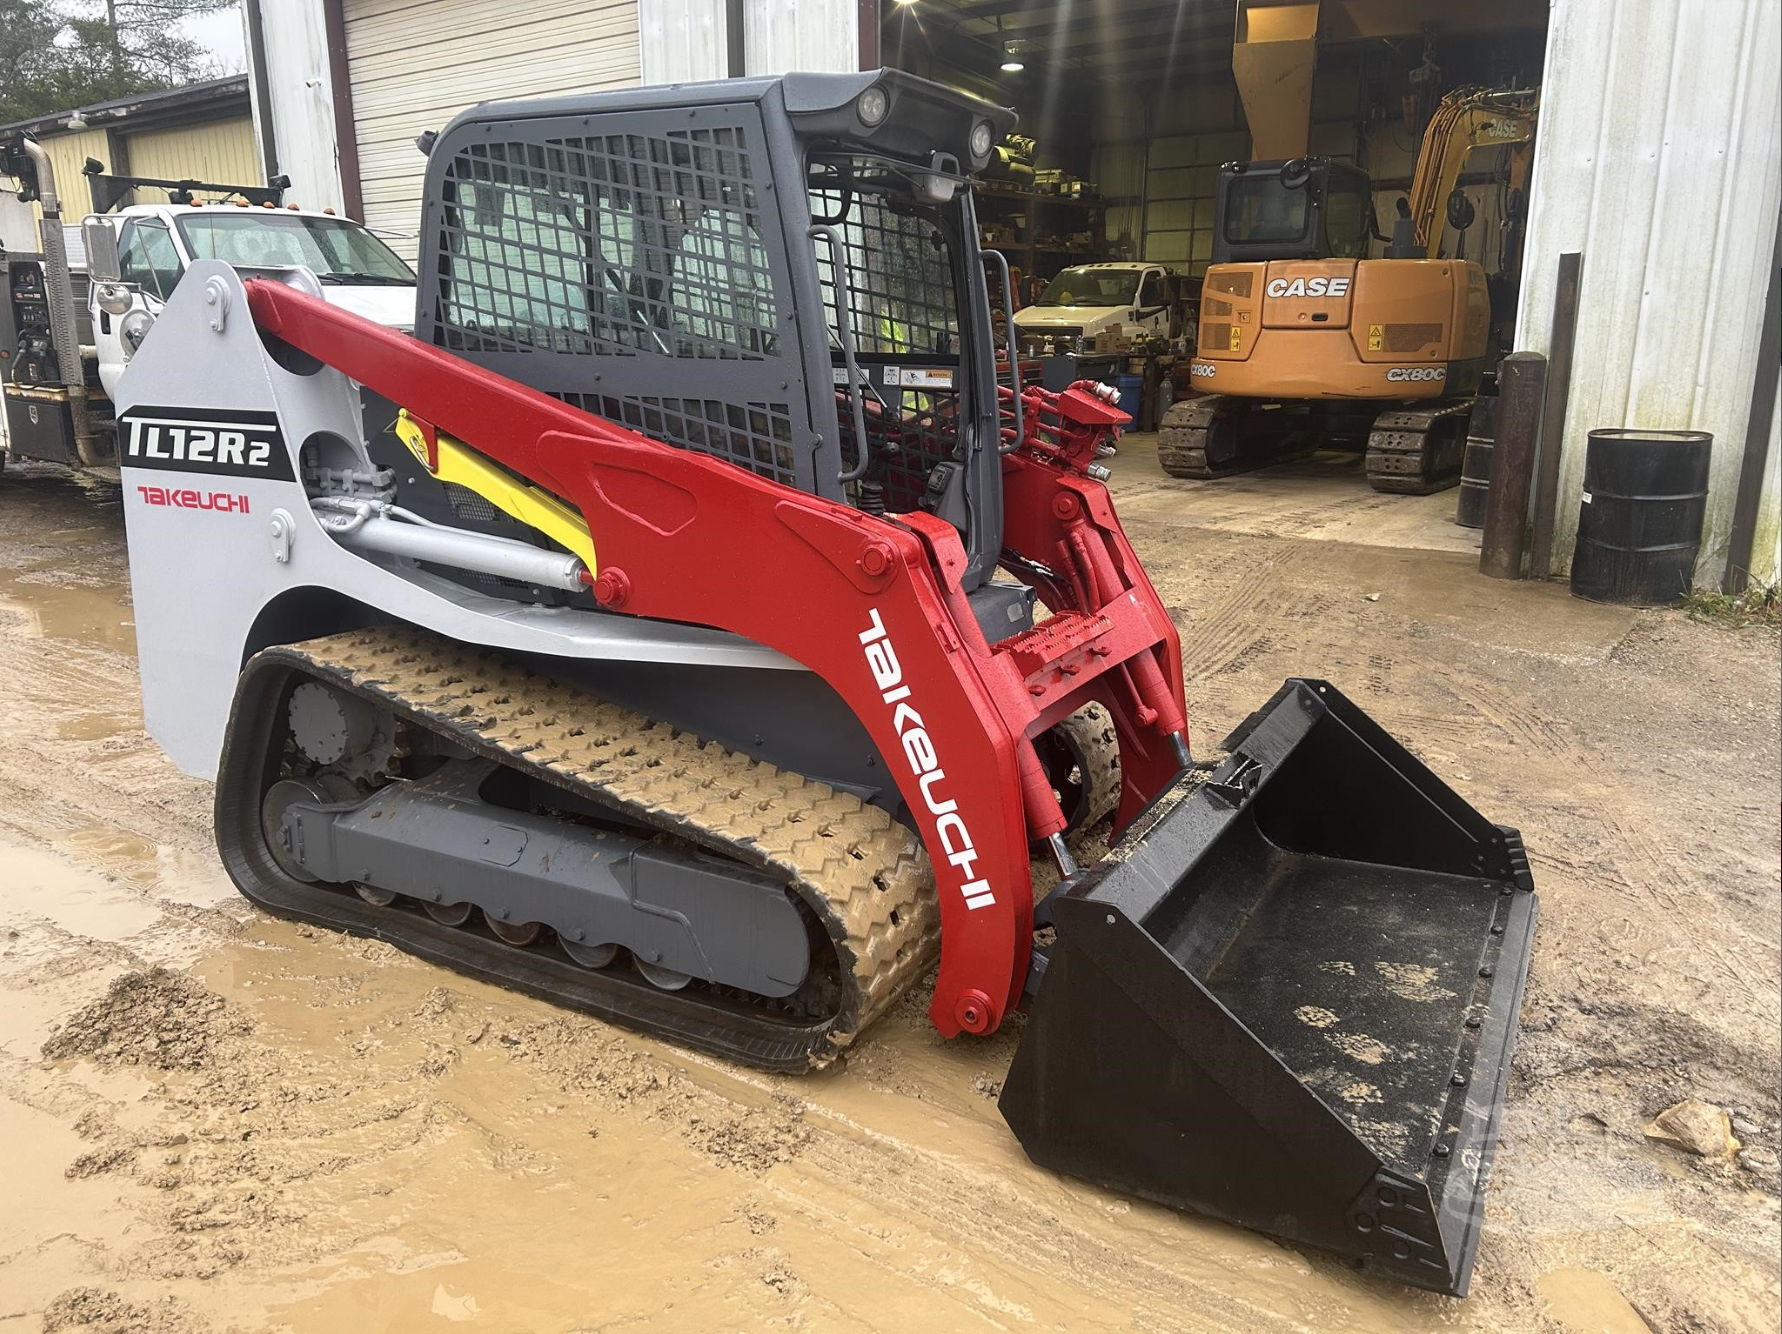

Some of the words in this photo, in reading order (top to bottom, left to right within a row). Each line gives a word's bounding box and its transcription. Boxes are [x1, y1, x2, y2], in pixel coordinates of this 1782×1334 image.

[1489, 118, 1517, 138] CASE
[1267, 276, 1350, 298] CASE
[1191, 364, 1216, 378] CX80C
[1387, 368, 1446, 381] CX80C
[123, 417, 277, 467] TL12R2
